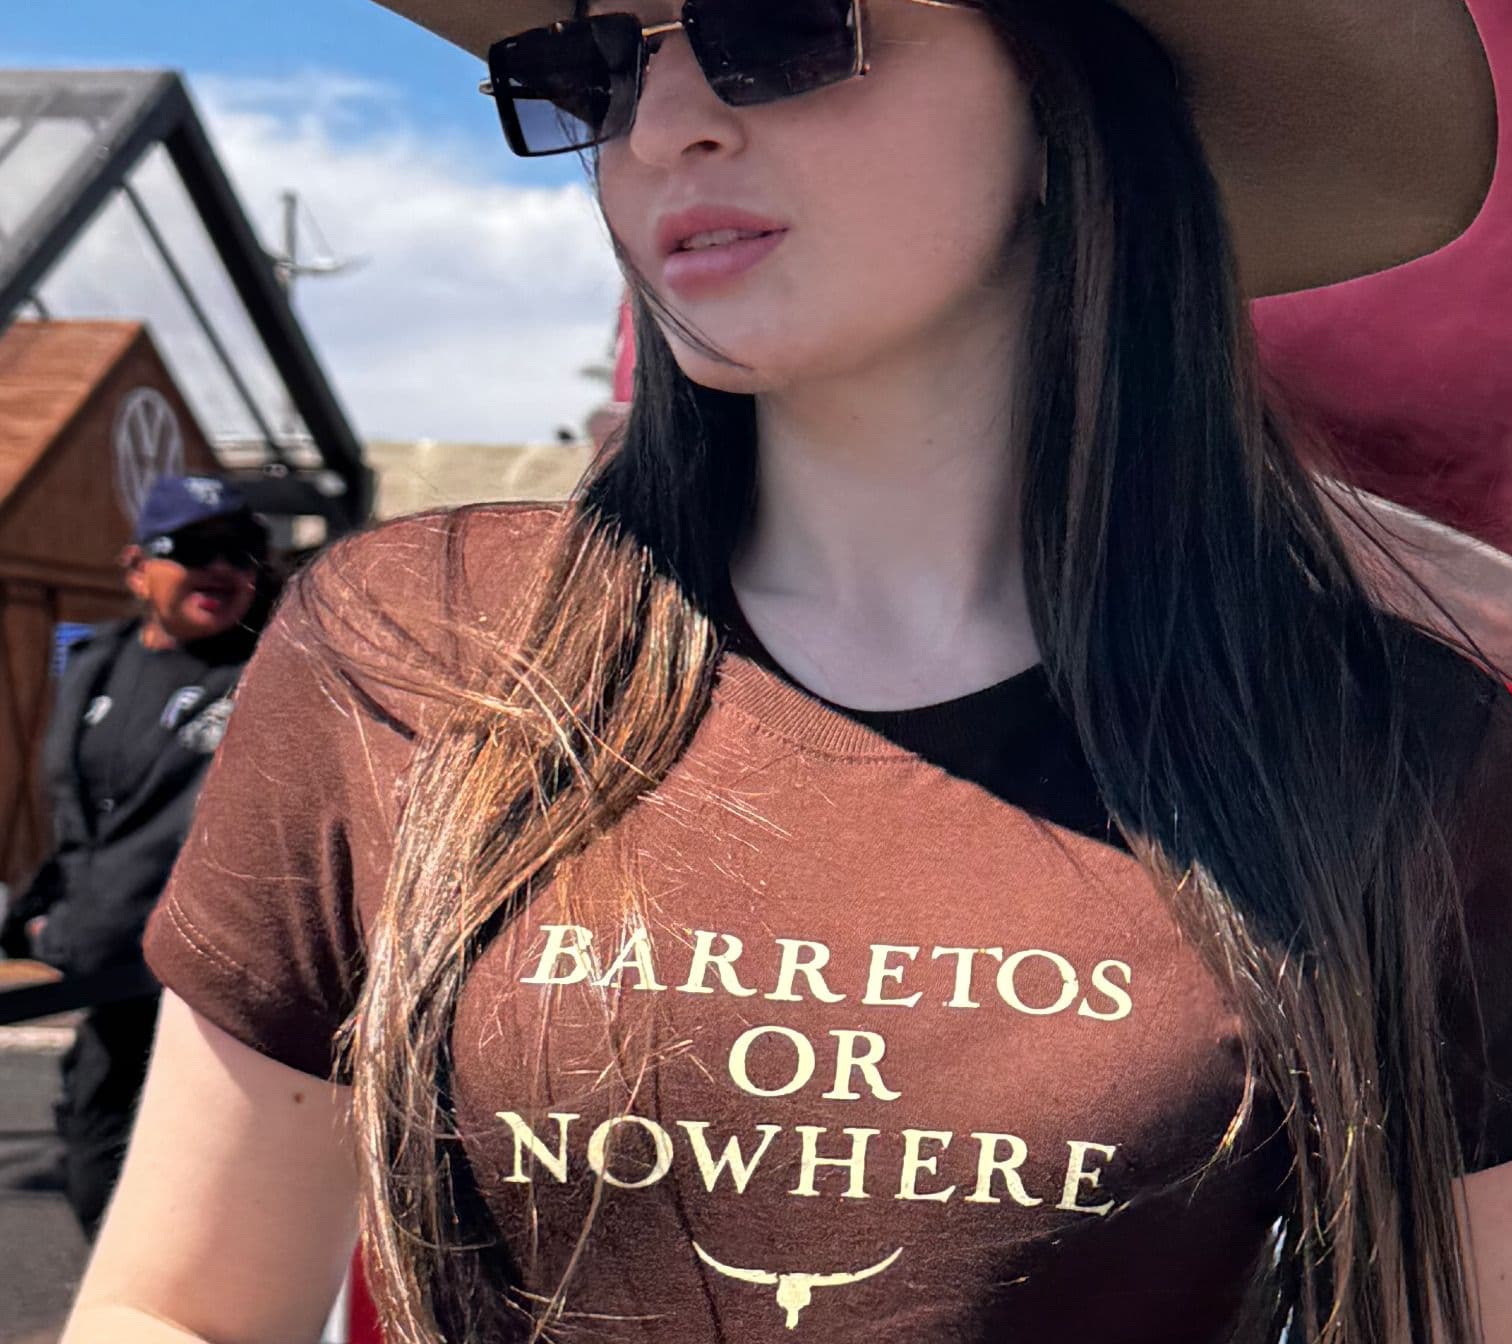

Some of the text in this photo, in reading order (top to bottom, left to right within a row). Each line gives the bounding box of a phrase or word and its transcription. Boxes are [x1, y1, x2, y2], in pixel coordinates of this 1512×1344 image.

[520, 924, 1132, 1021] BARRETOS
[728, 1025, 902, 1101] OR
[495, 1111, 1118, 1216] NOWHERE
